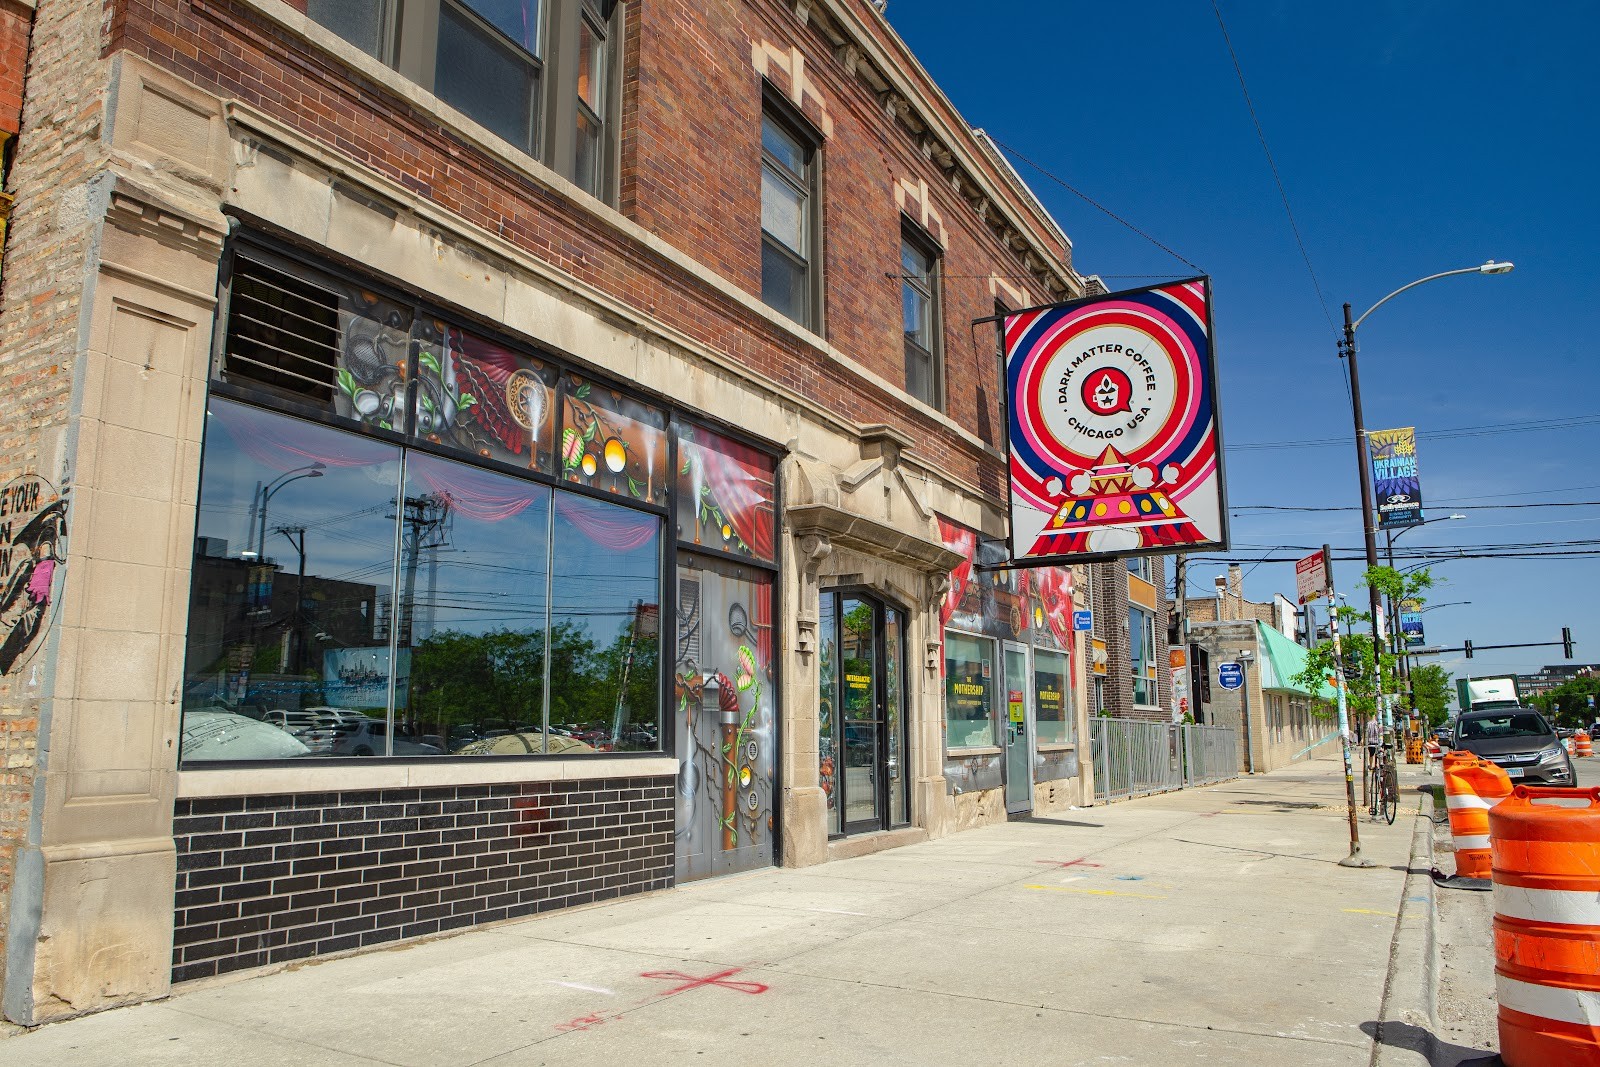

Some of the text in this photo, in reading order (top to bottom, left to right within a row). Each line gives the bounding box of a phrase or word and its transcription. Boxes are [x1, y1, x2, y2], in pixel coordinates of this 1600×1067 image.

[1058, 343, 1156, 405] DARK MATTER COFFEE
[1068, 406, 1151, 439] CHICAGO USA
[1374, 457, 1416, 469] UKRAINIAN
[1375, 466, 1417, 480] VILLAGE
[11, 482, 40, 514] YOUR
[954, 683, 984, 695] MOTHERSHIP
